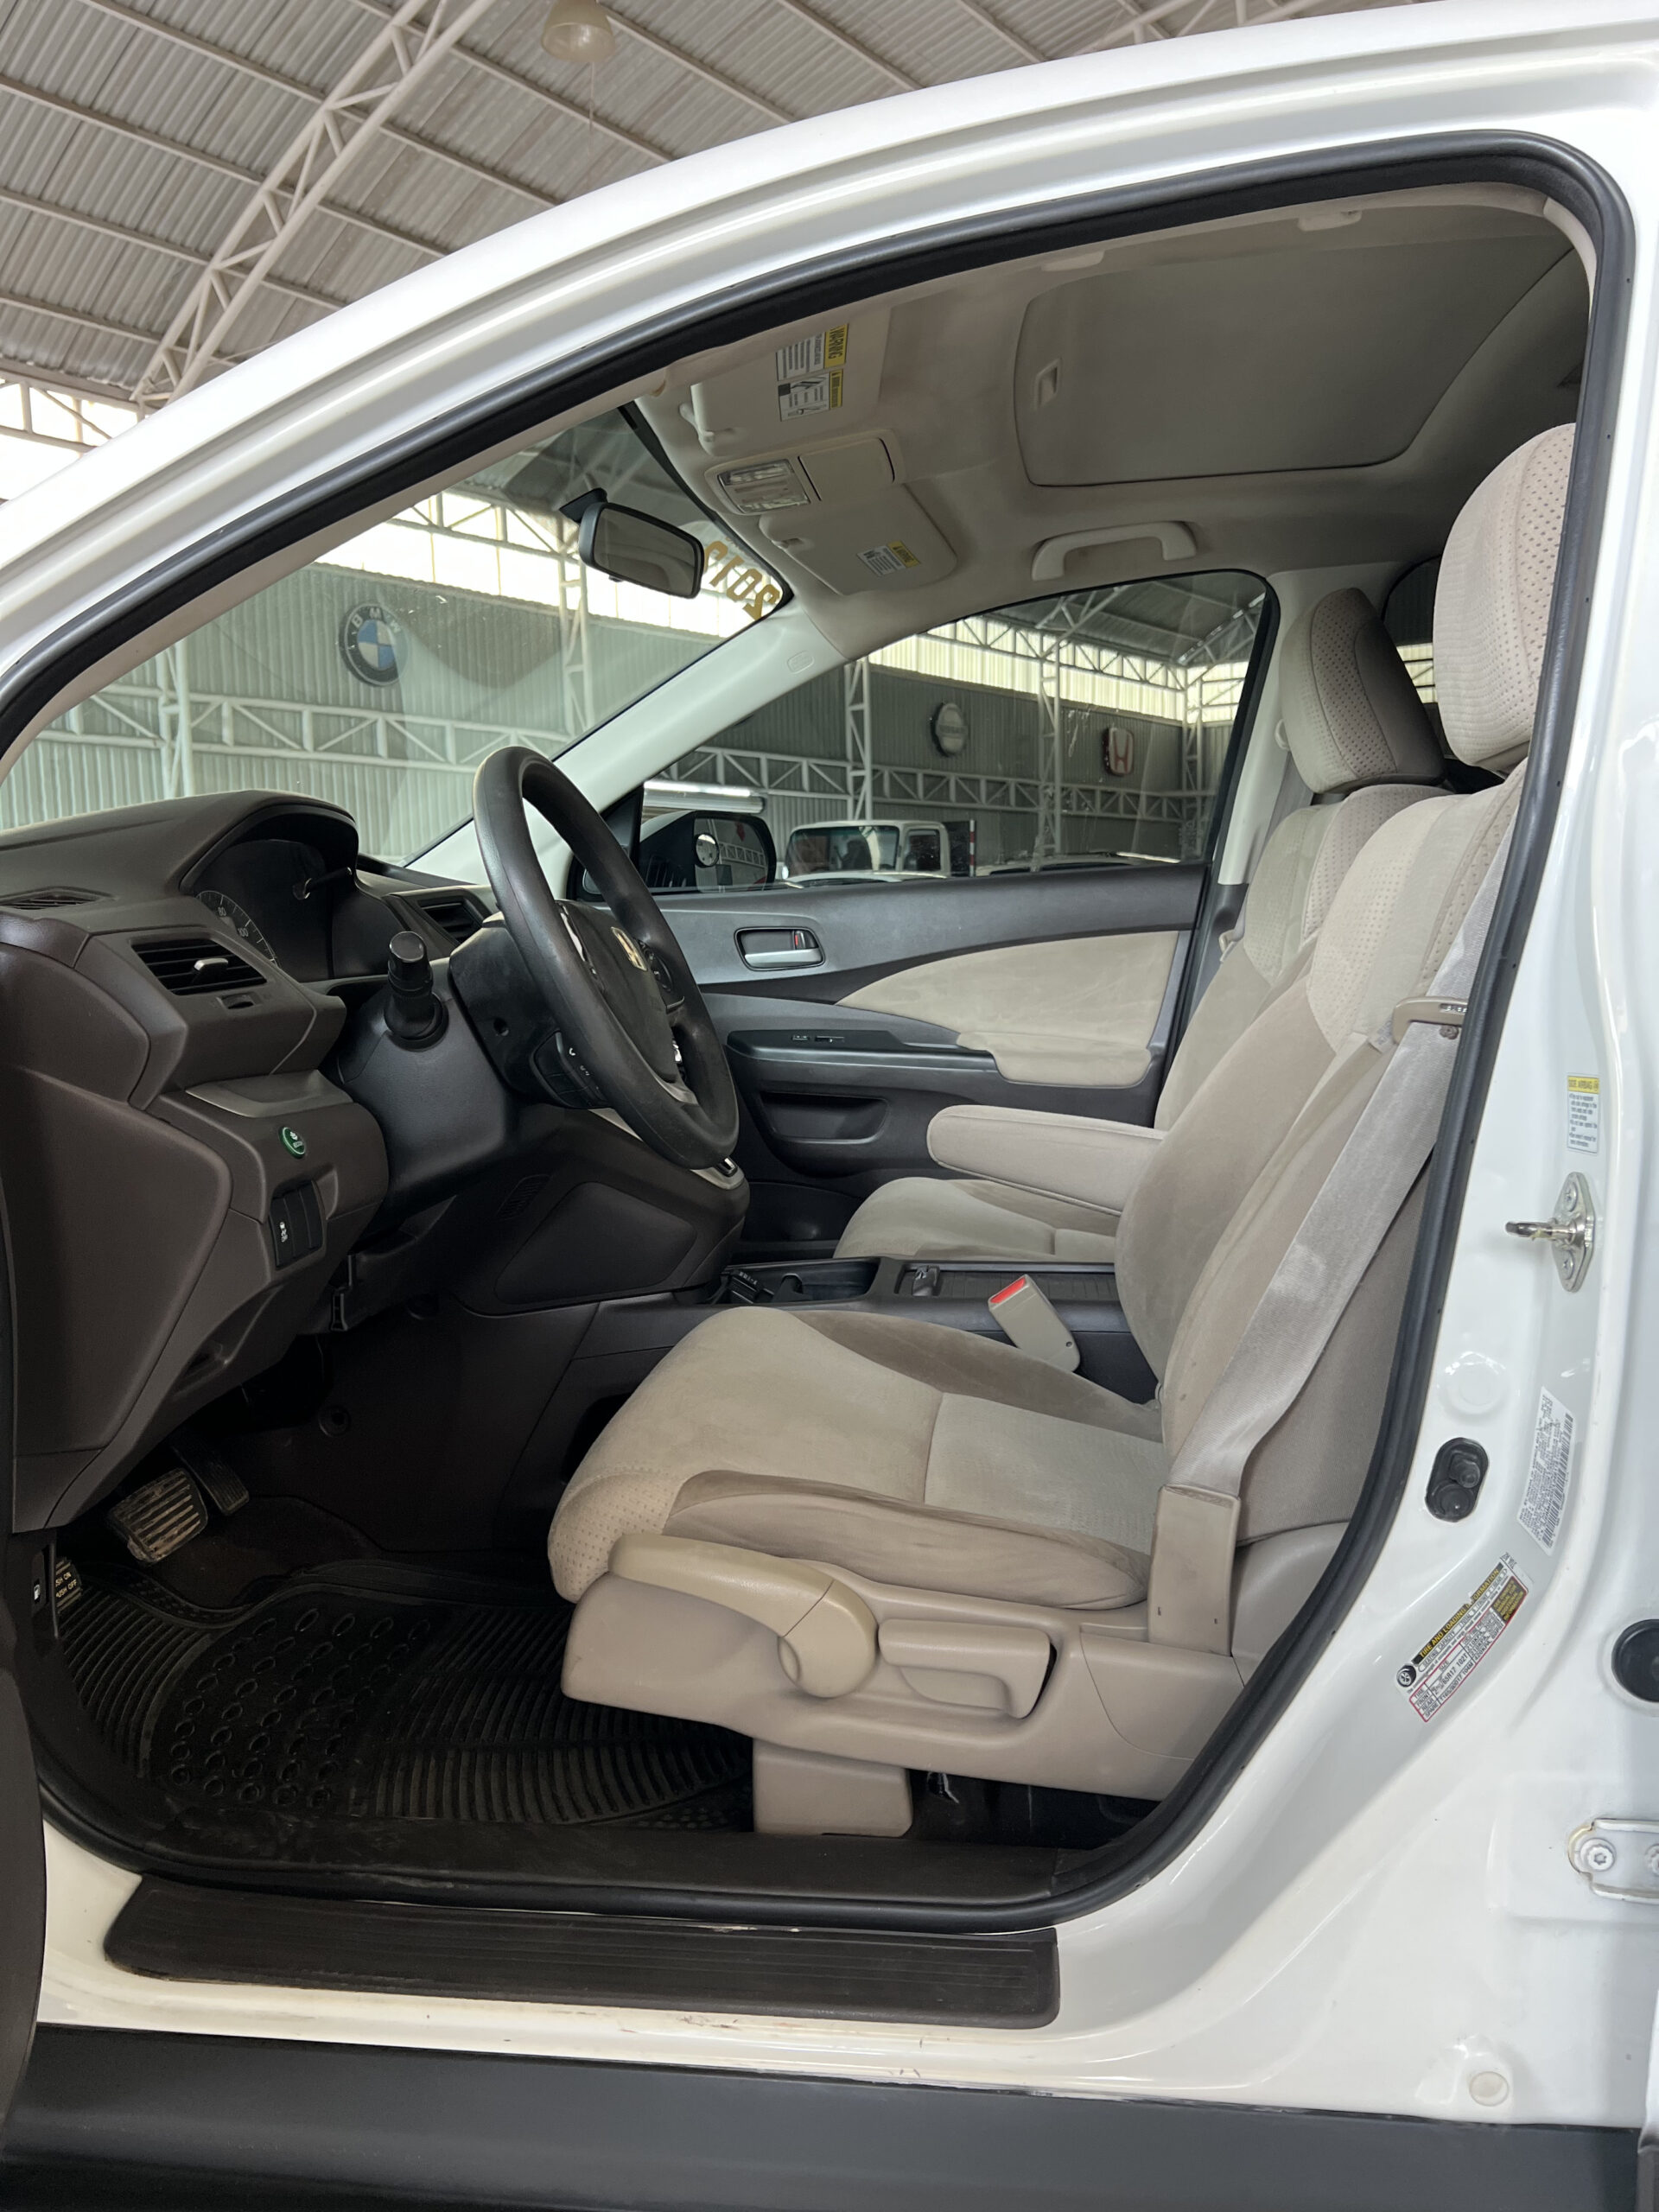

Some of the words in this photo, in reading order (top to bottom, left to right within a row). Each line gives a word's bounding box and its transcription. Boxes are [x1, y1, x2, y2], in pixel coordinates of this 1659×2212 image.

[829, 327, 844, 359] WARNING
[217, 906, 227, 917] 80
[237, 927, 249, 938] 100
[1419, 1643, 1433, 1657] TIRE
[1430, 1631, 1443, 1645] AND
[1442, 1609, 1465, 1632] LOADING
[1465, 1568, 1498, 1608] IORMATION
[1455, 1652, 1468, 1666] 102T
